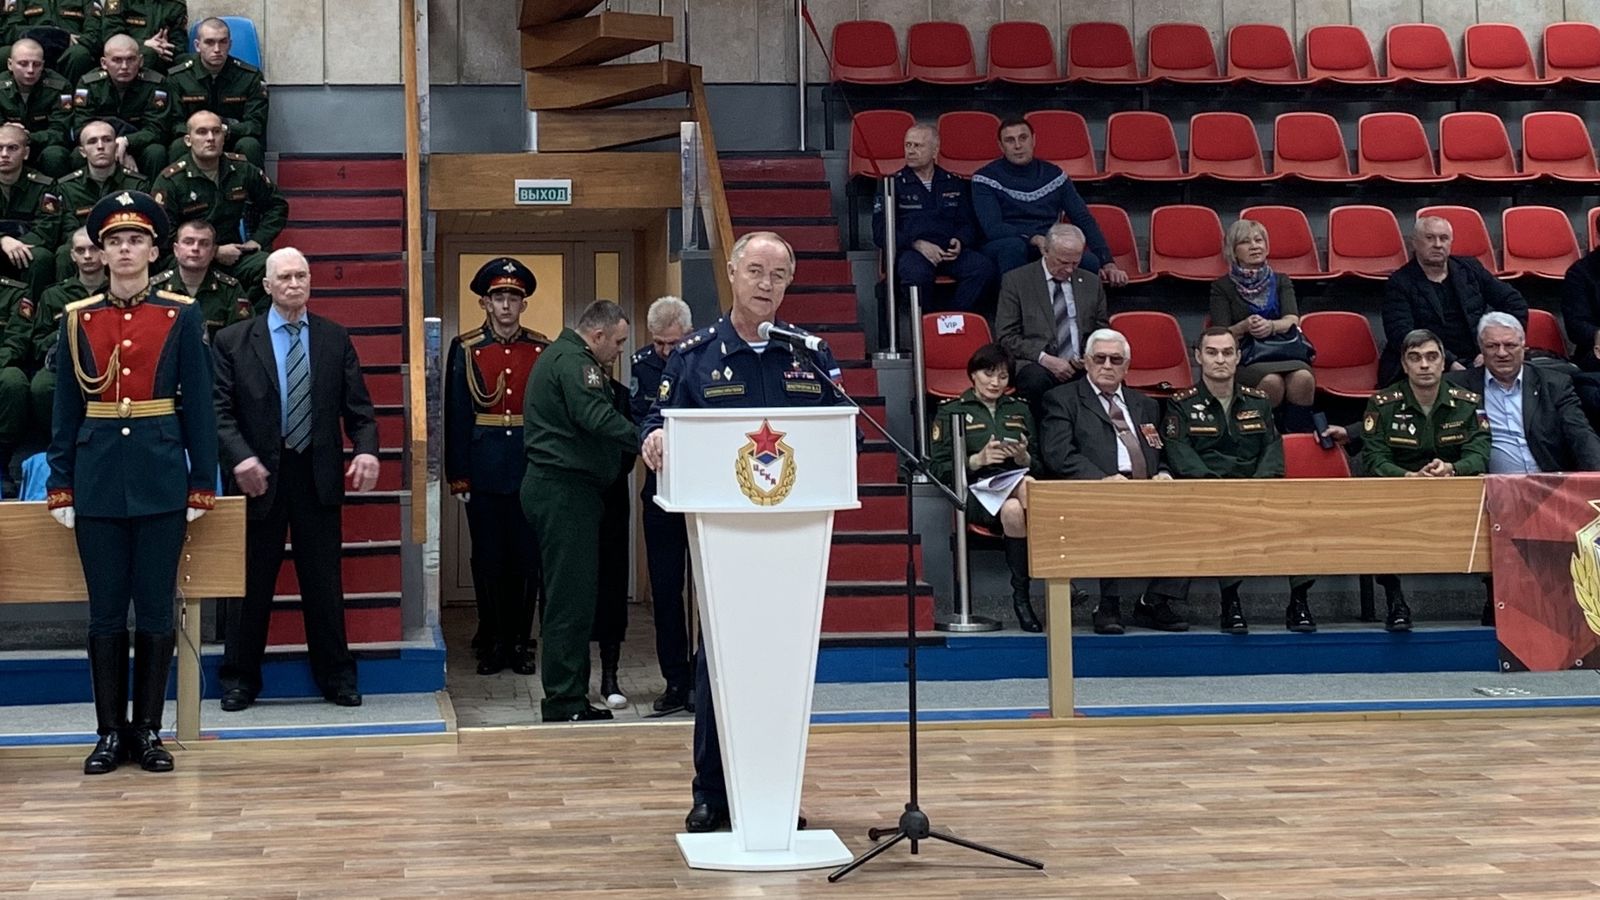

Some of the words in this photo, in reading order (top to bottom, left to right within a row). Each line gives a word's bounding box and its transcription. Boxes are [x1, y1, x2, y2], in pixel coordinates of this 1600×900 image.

[337, 166, 346, 179] 4
[520, 189, 566, 201] ВЫХОД
[334, 266, 343, 280] 3
[944, 321, 958, 329] VIP
[753, 464, 776, 485] ЦСКА
